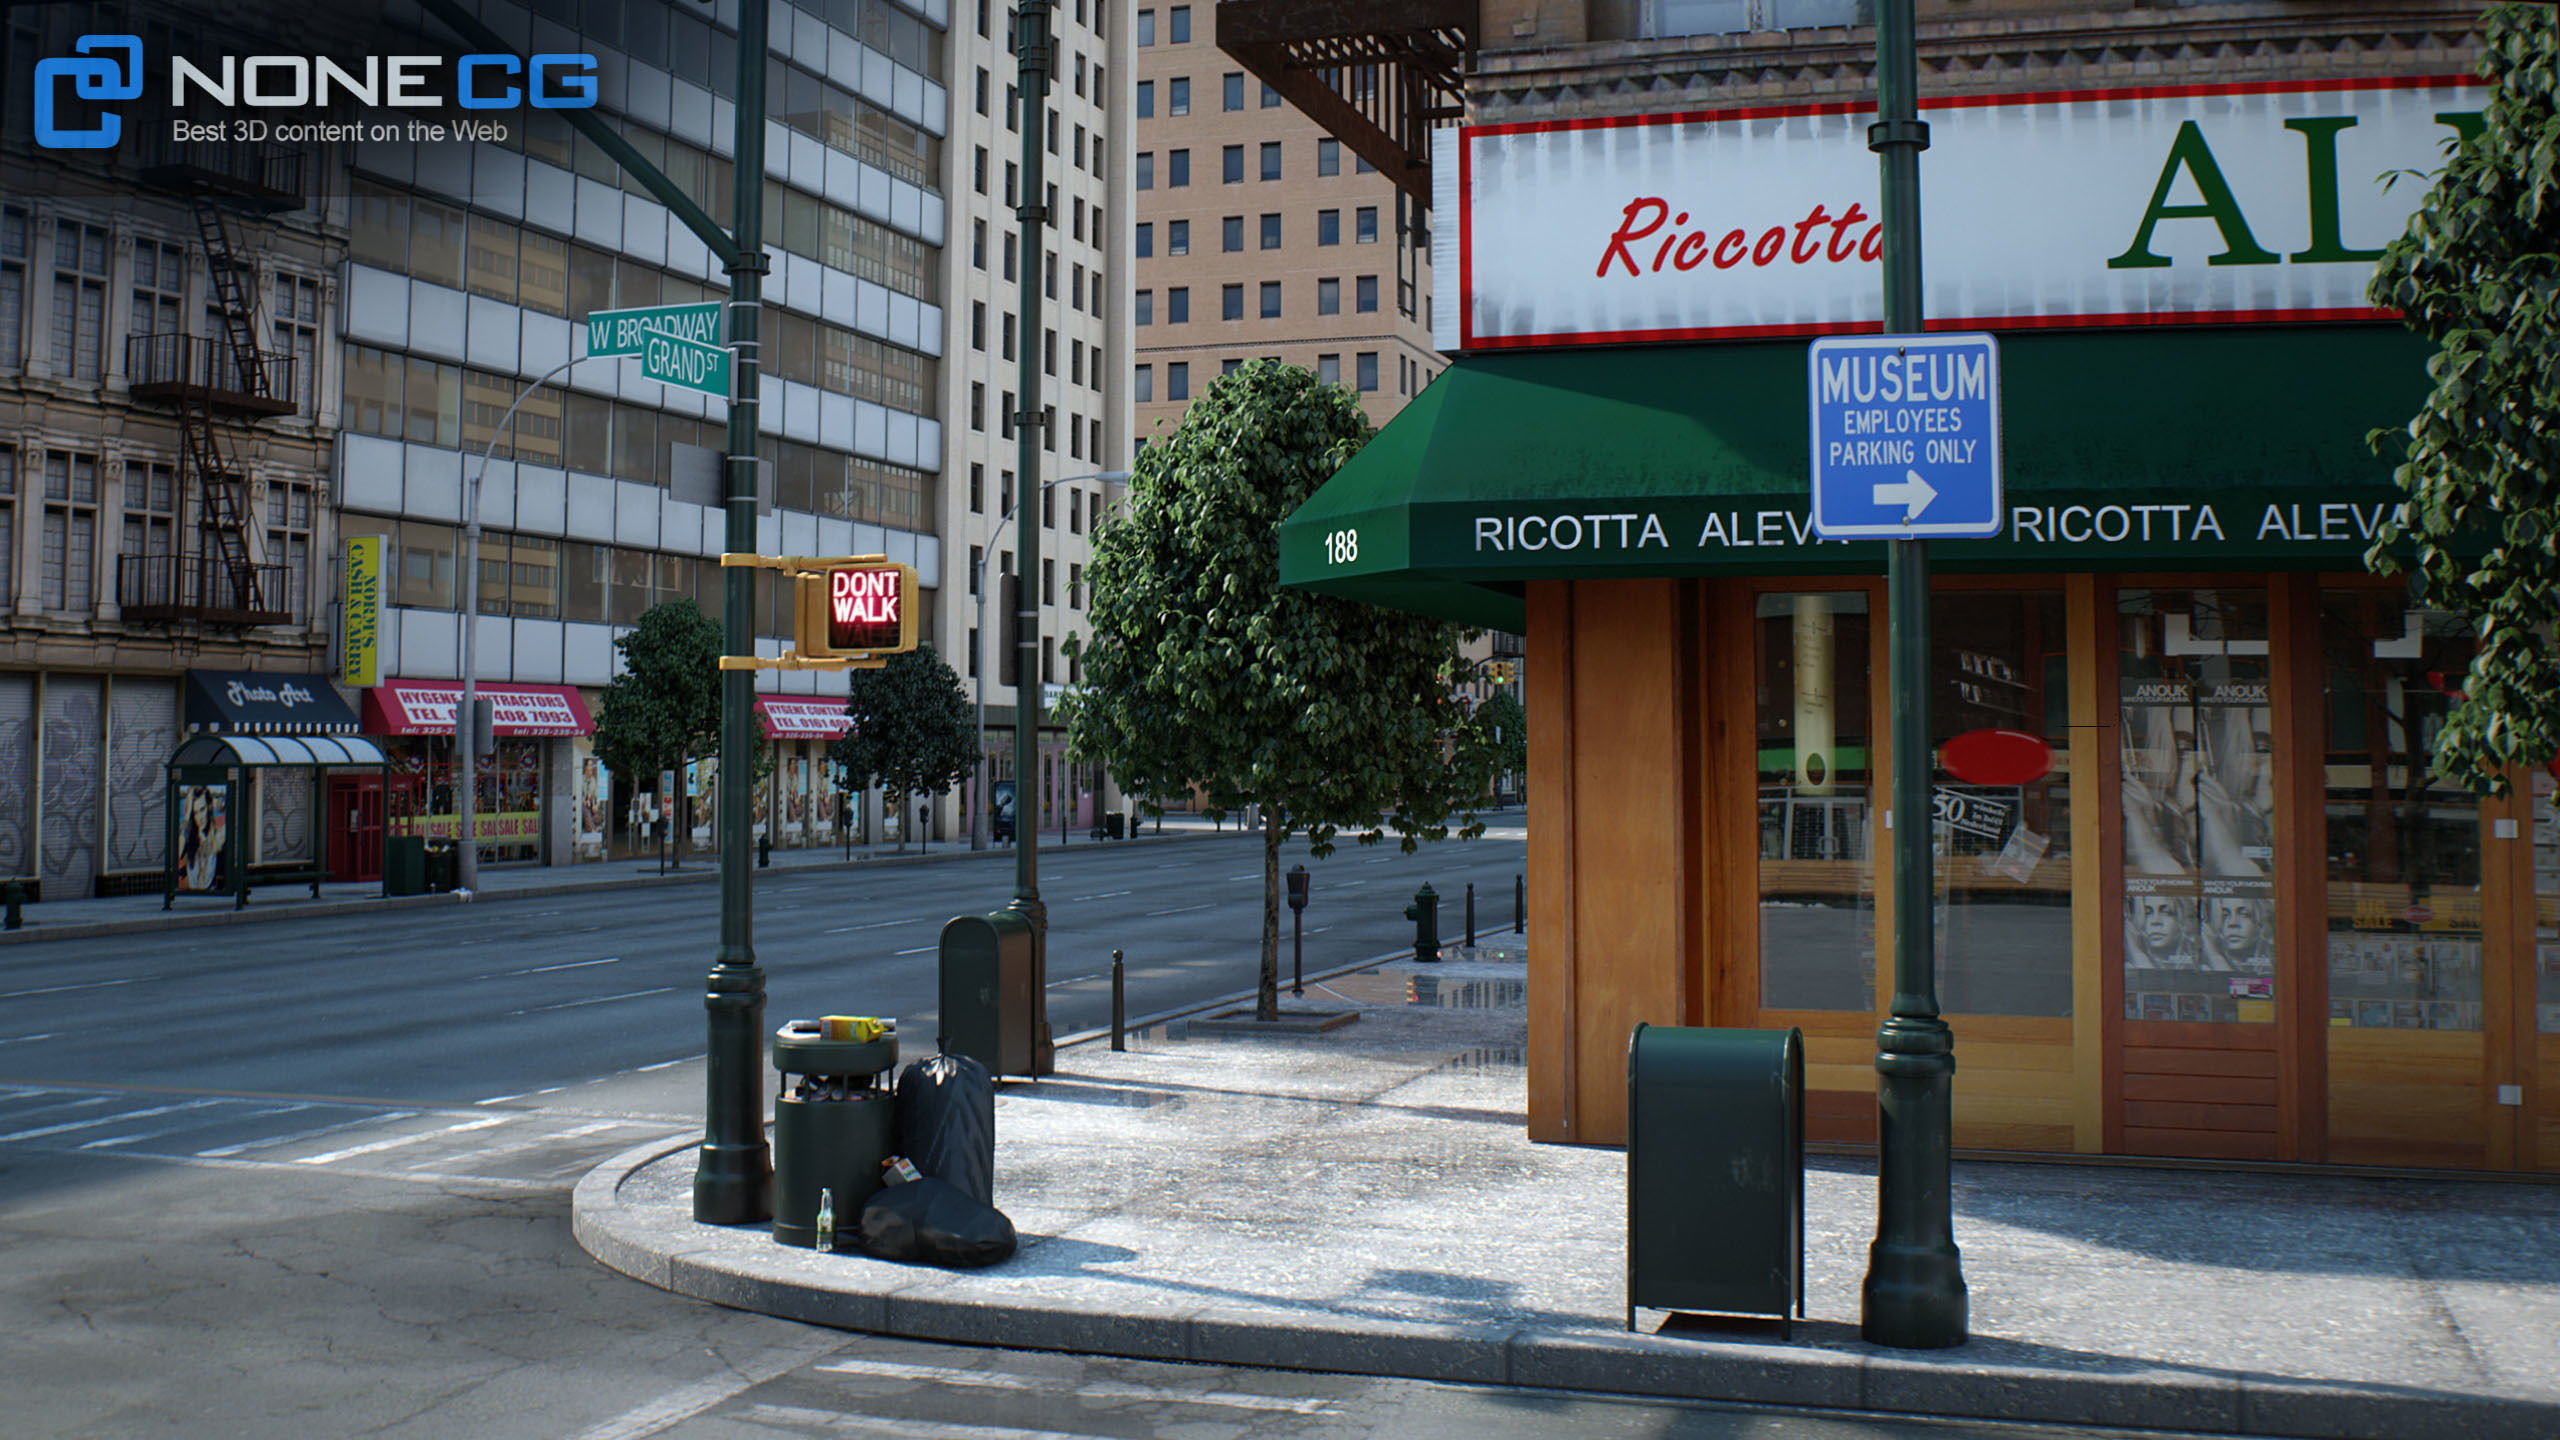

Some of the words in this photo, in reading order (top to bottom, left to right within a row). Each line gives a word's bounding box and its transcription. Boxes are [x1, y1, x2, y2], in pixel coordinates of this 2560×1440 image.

[2107, 112, 2487, 269] AL
[591, 319, 612, 350] W
[617, 310, 719, 349] BROADWAY
[647, 336, 706, 385] GRAND
[706, 352, 720, 373] ST
[1821, 352, 1986, 404] MUSEUM
[1844, 407, 1963, 435] EMPLOYEES
[1829, 440, 1915, 467] PARKING
[1925, 439, 1977, 465] ONLY
[1473, 512, 1671, 552] RICOTTA
[1697, 509, 1849, 546] ALEV
[2011, 503, 2228, 543] RICOTTA
[1324, 528, 1358, 565] 188
[350, 543, 364, 594] CASH
[832, 571, 900, 597] DONT
[832, 596, 899, 623] WALK
[348, 613, 362, 679] CARRY
[226, 679, 278, 708] Photo
[278, 682, 315, 708] Art
[2135, 684, 2189, 697] ANOUK
[2213, 685, 2269, 698] ANOUK
[1931, 793, 1966, 822] 50
[499, 819, 519, 835] SALE
